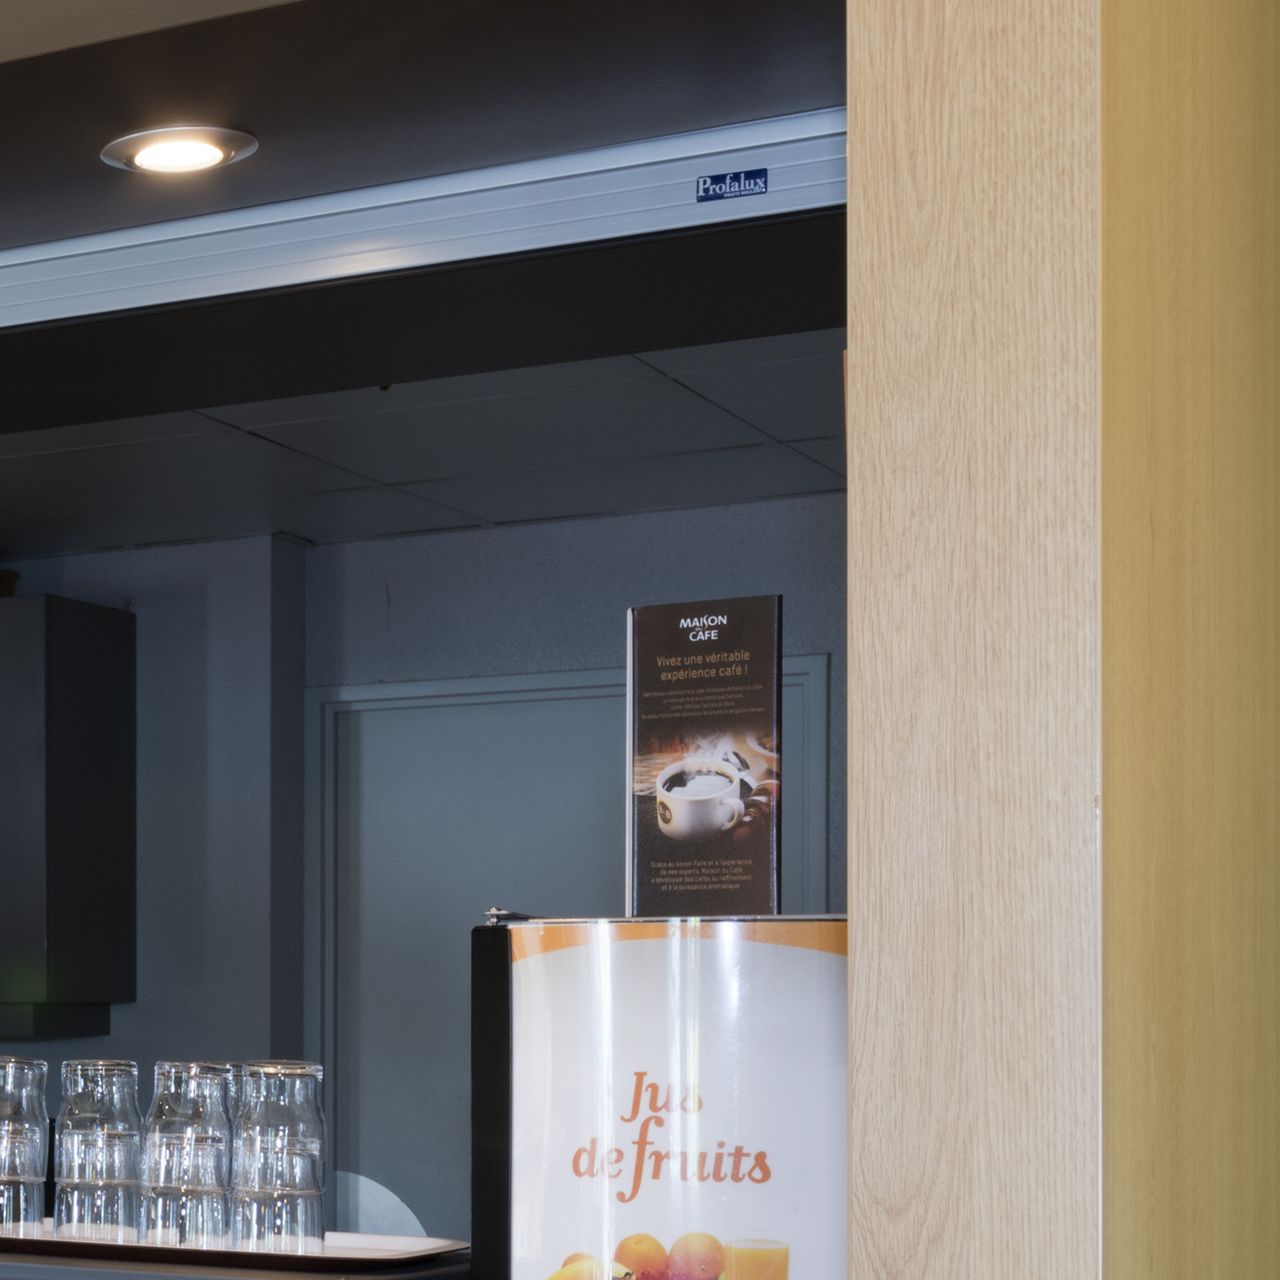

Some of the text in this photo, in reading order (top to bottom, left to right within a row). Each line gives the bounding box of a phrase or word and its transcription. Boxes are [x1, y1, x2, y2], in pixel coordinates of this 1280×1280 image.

[697, 172, 765, 196] Profalux
[680, 615, 727, 628] MAISON
[657, 649, 750, 667] Vivez une véritable
[661, 668, 716, 681] expérience
[719, 664, 742, 676] café
[620, 1071, 704, 1123] Jus
[572, 1116, 772, 1203] de fruits
